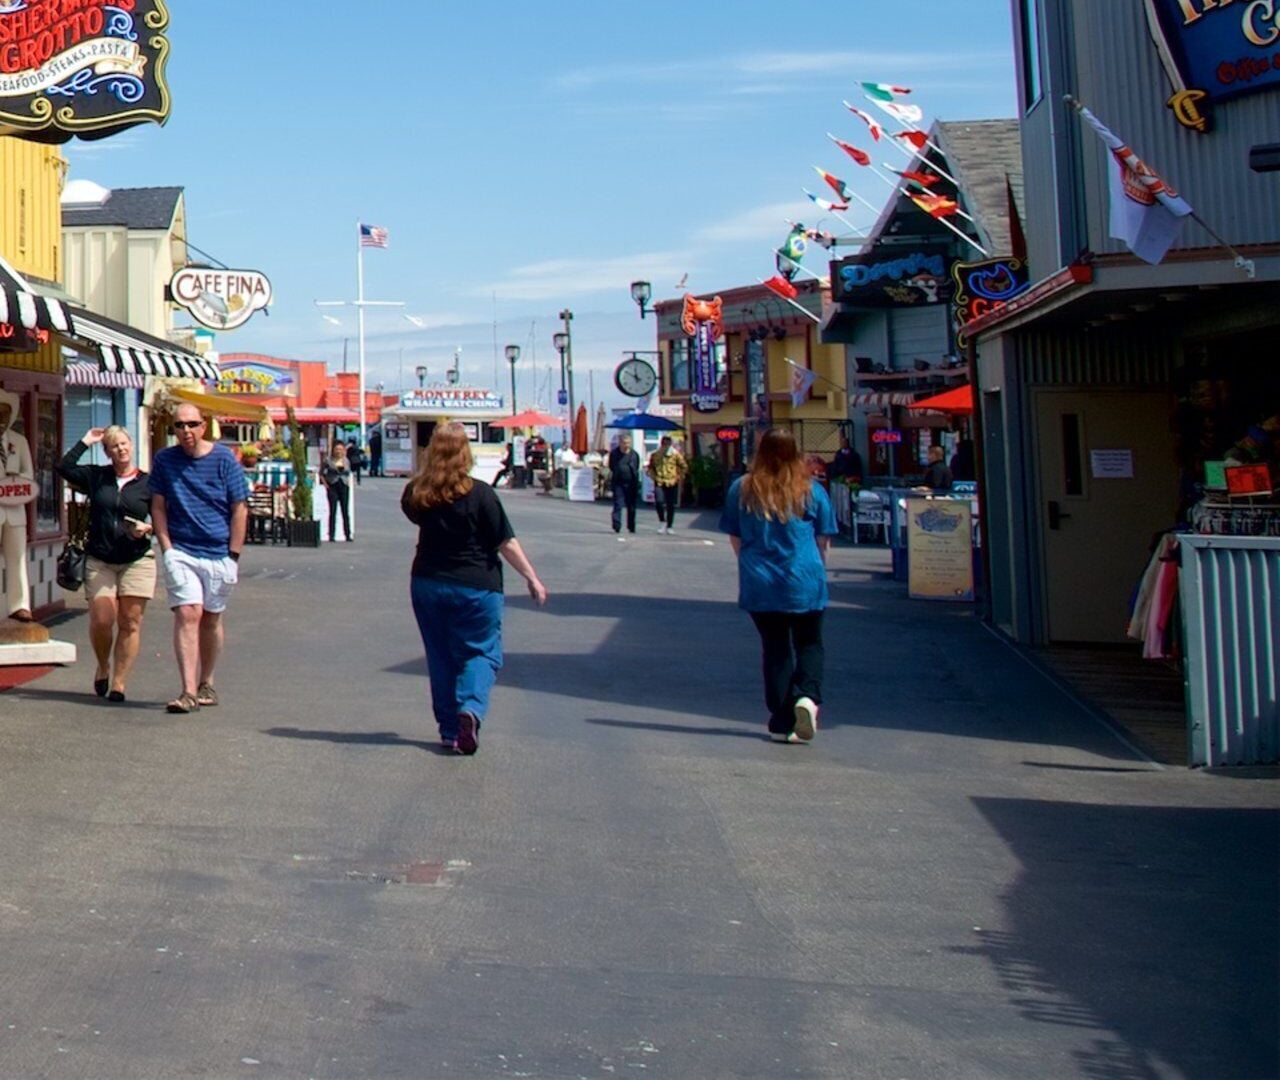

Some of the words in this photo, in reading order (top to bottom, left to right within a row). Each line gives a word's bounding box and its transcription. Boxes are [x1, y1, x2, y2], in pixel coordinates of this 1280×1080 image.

[0, 6, 105, 74] GROTTO
[176, 273, 222, 301] CAFE
[227, 275, 265, 302] FINA
[413, 389, 490, 399] MONTEREY
[404, 398, 441, 408] WHALE
[443, 398, 500, 408] WATCHING
[718, 431, 740, 440] OPEN
